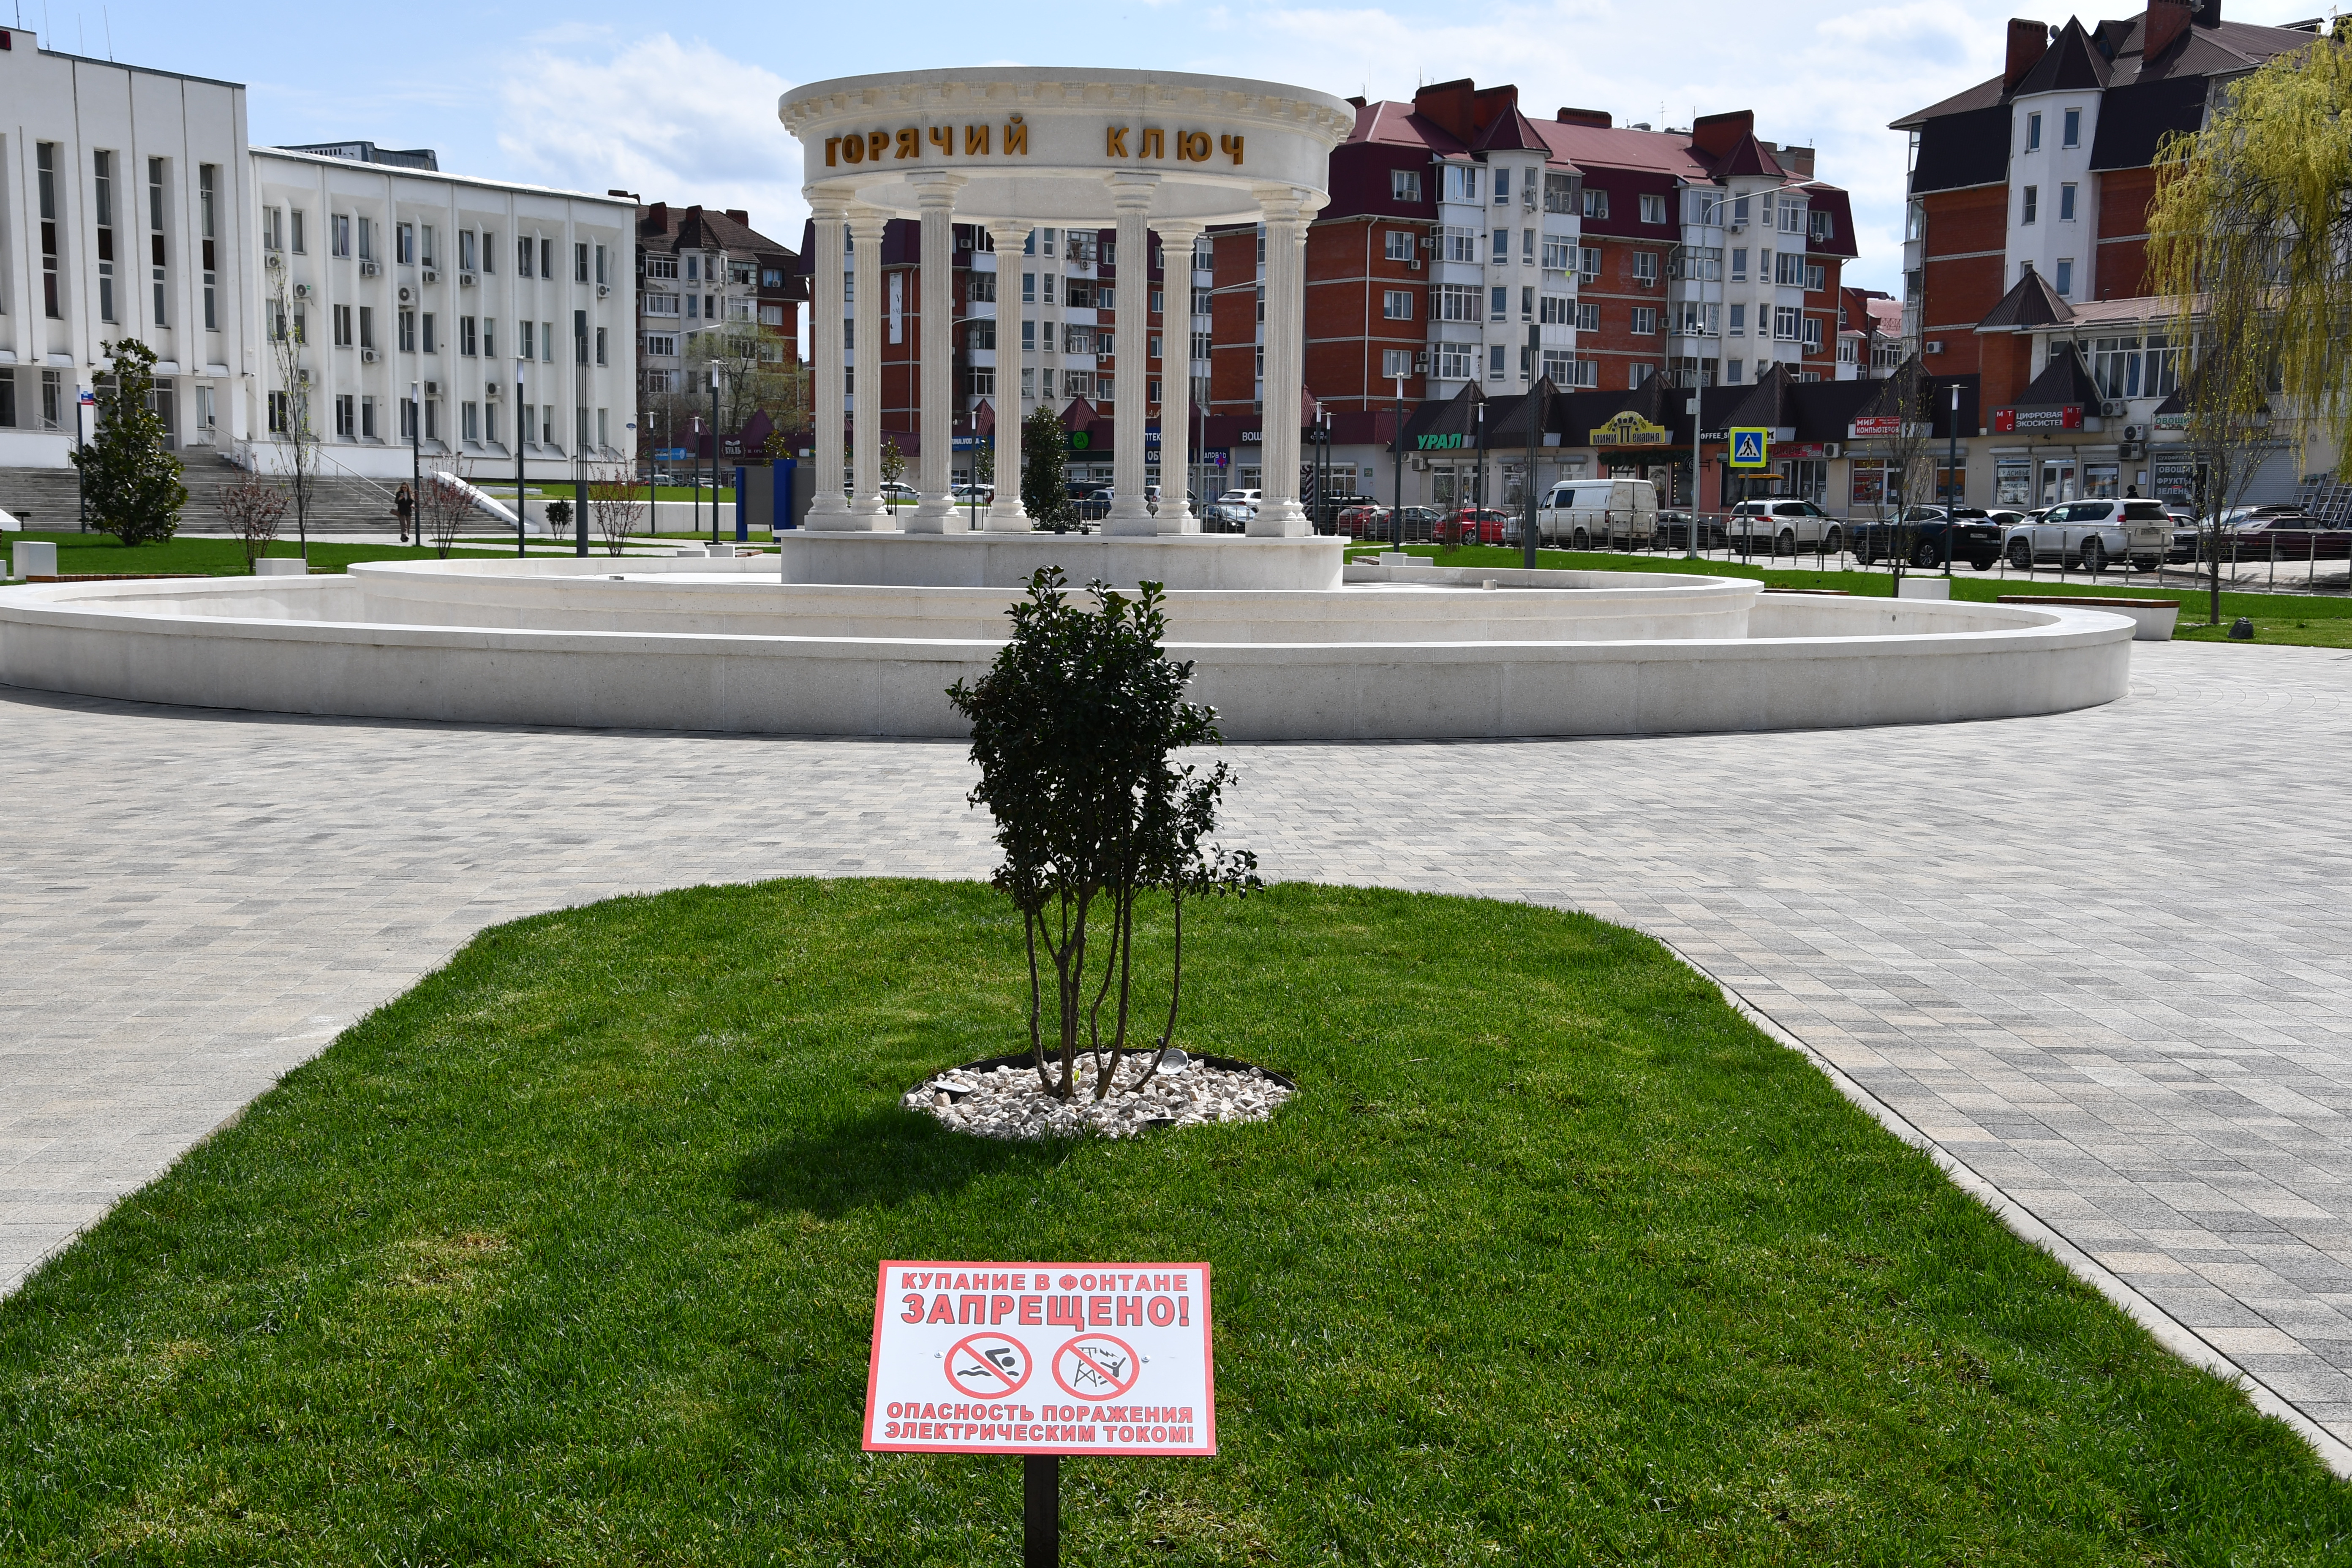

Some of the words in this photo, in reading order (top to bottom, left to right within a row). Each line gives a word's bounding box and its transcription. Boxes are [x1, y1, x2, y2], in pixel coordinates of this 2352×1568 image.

[825, 117, 1028, 167] ГОРЯЧИЙ
[1107, 127, 1244, 165] КЛЮЧ
[1145, 433, 1161, 441] ПТЕК
[1417, 433, 1462, 450] УРАЛ
[1700, 432, 1729, 440] OFFEE_S
[725, 446, 742, 455] ВУАЛЬ
[2159, 466, 2191, 474] ОВОЩИ
[902, 1273, 1025, 1290] КУПАНИЕ
[1035, 1274, 1050, 1290] В
[1059, 1274, 1187, 1291] ФОНТАНЕ
[901, 1293, 1189, 1332] ЗАПРЕЩЕНО!
[887, 1402, 1034, 1421] ОПАСНОСТЬ
[1042, 1405, 1192, 1423] ПОРАЖЕНИЯ
[885, 1422, 1095, 1442] ЭЛЕКТРИЧЕСКИМ
[1103, 1426, 1193, 1443] ТОКОМ!
